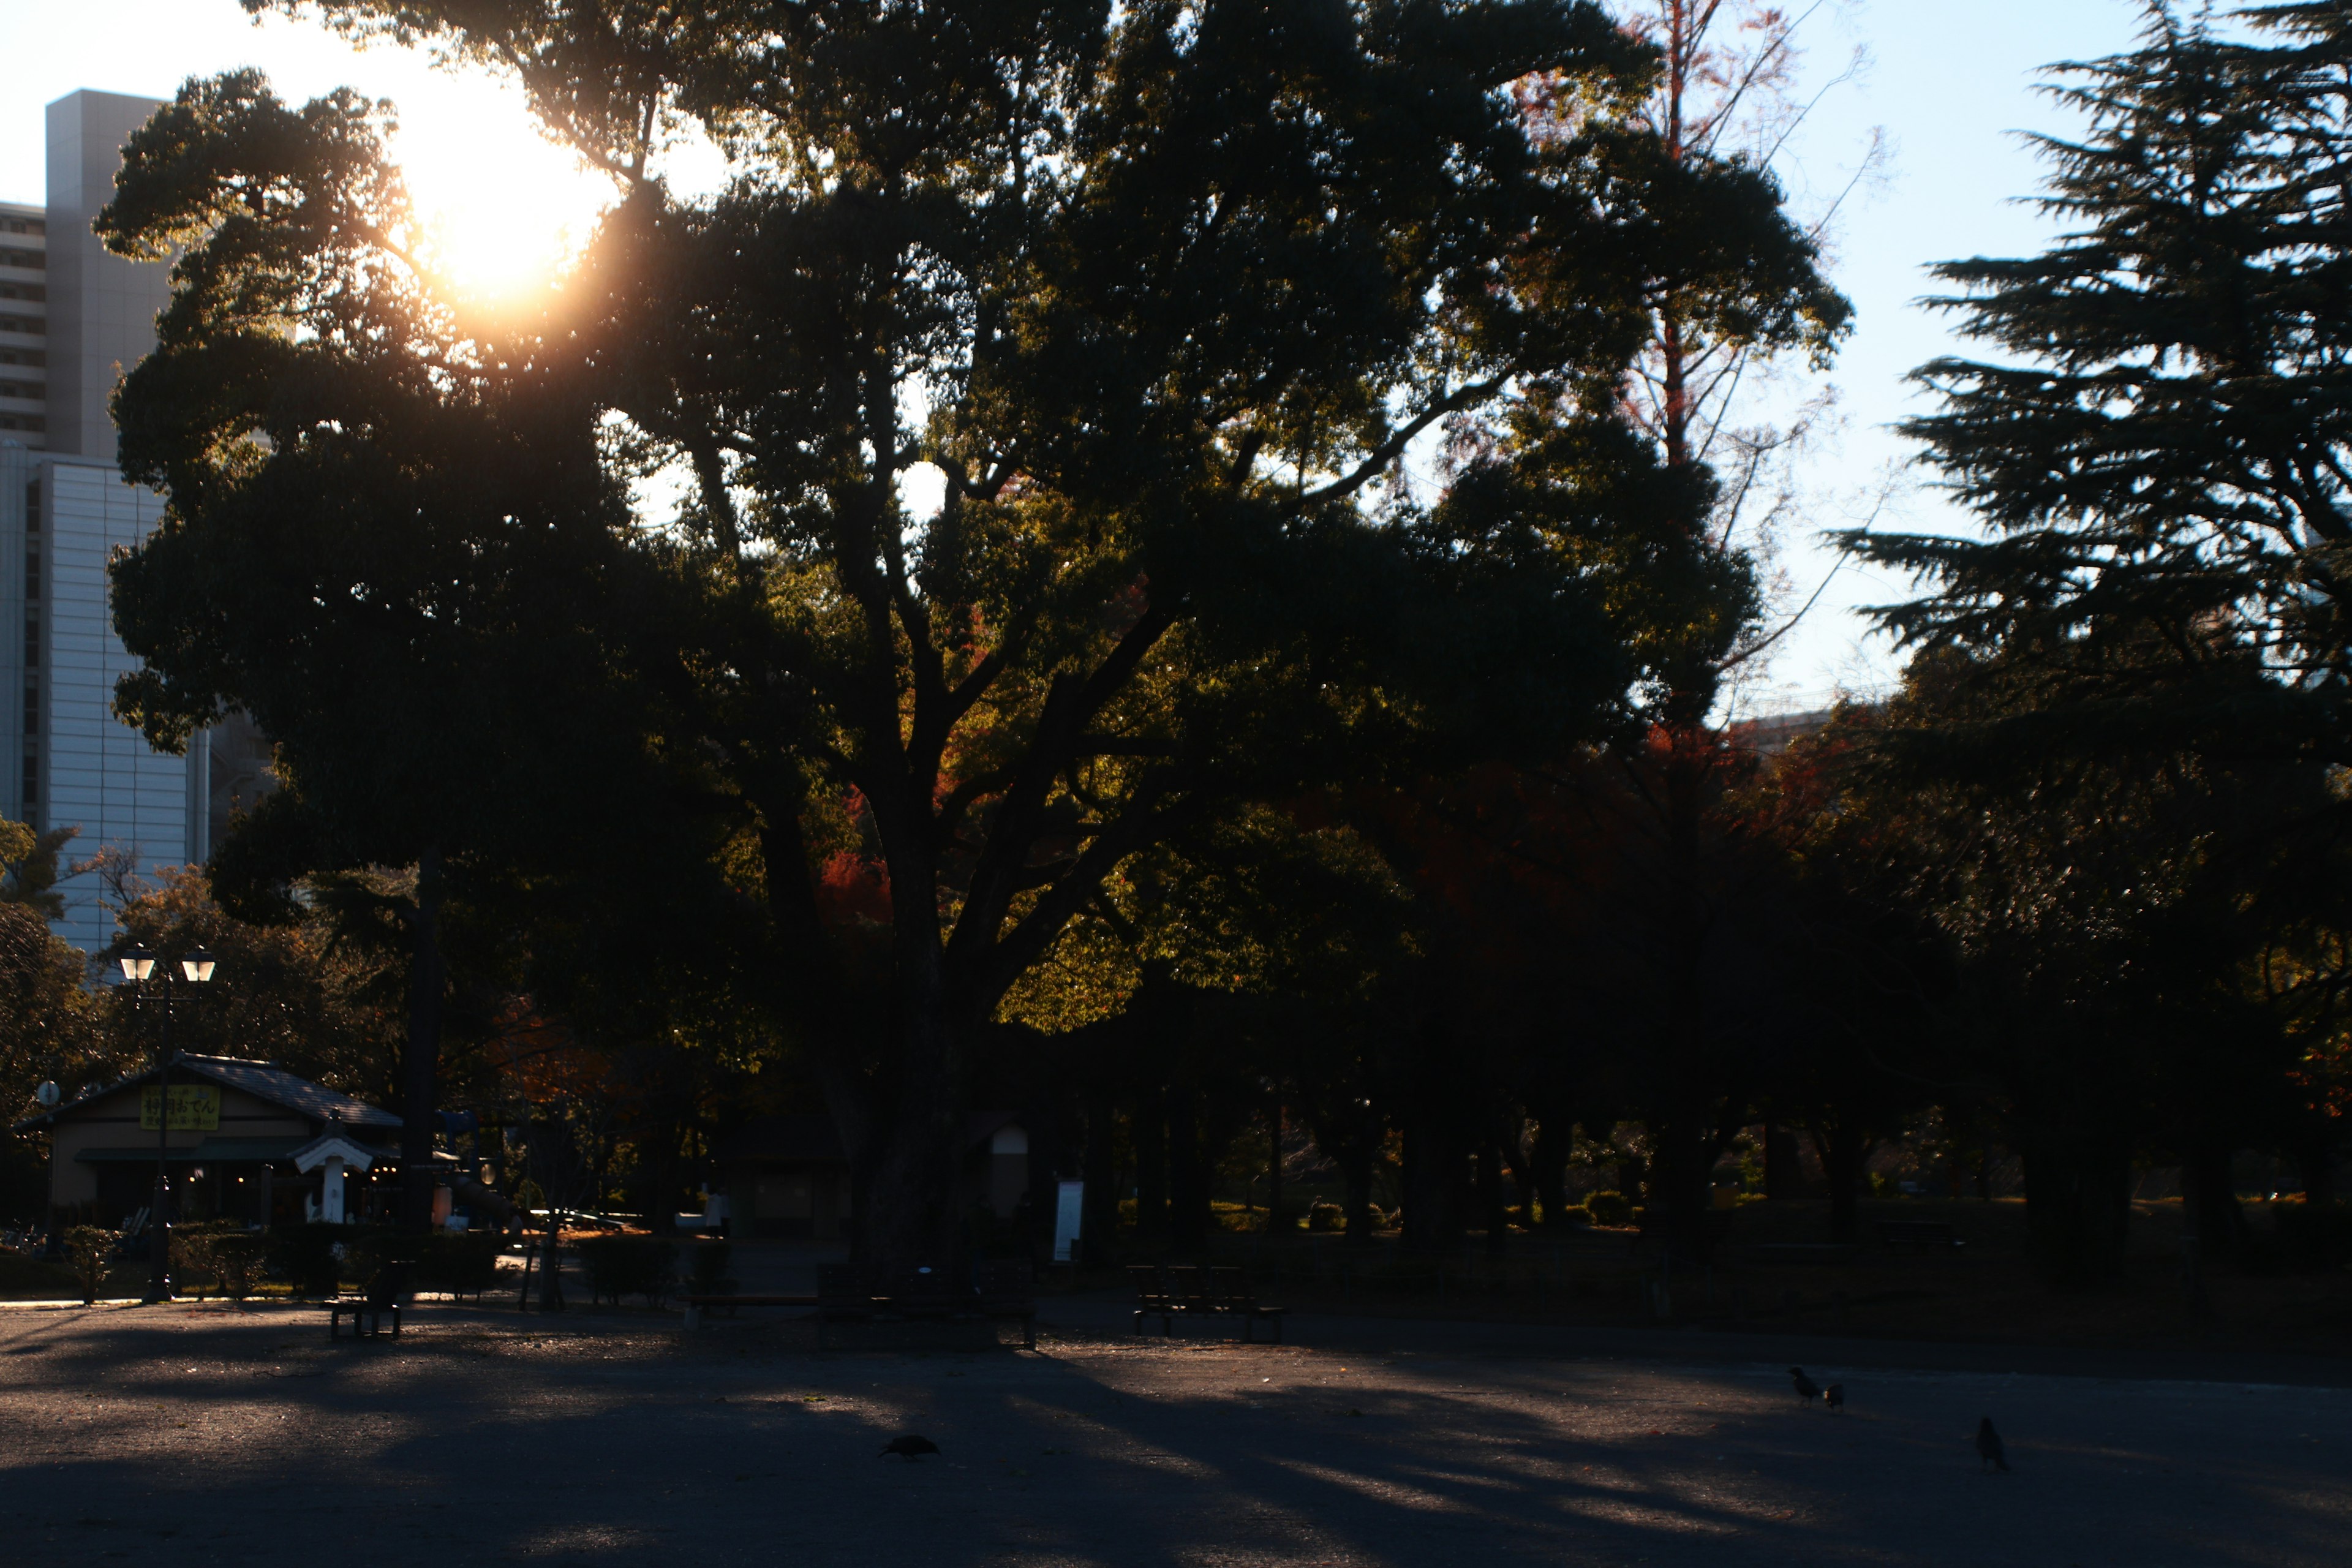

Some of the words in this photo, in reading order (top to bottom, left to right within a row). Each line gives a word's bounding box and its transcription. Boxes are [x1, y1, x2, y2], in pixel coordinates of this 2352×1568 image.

[144, 1097, 216, 1115] 静岡おでん
